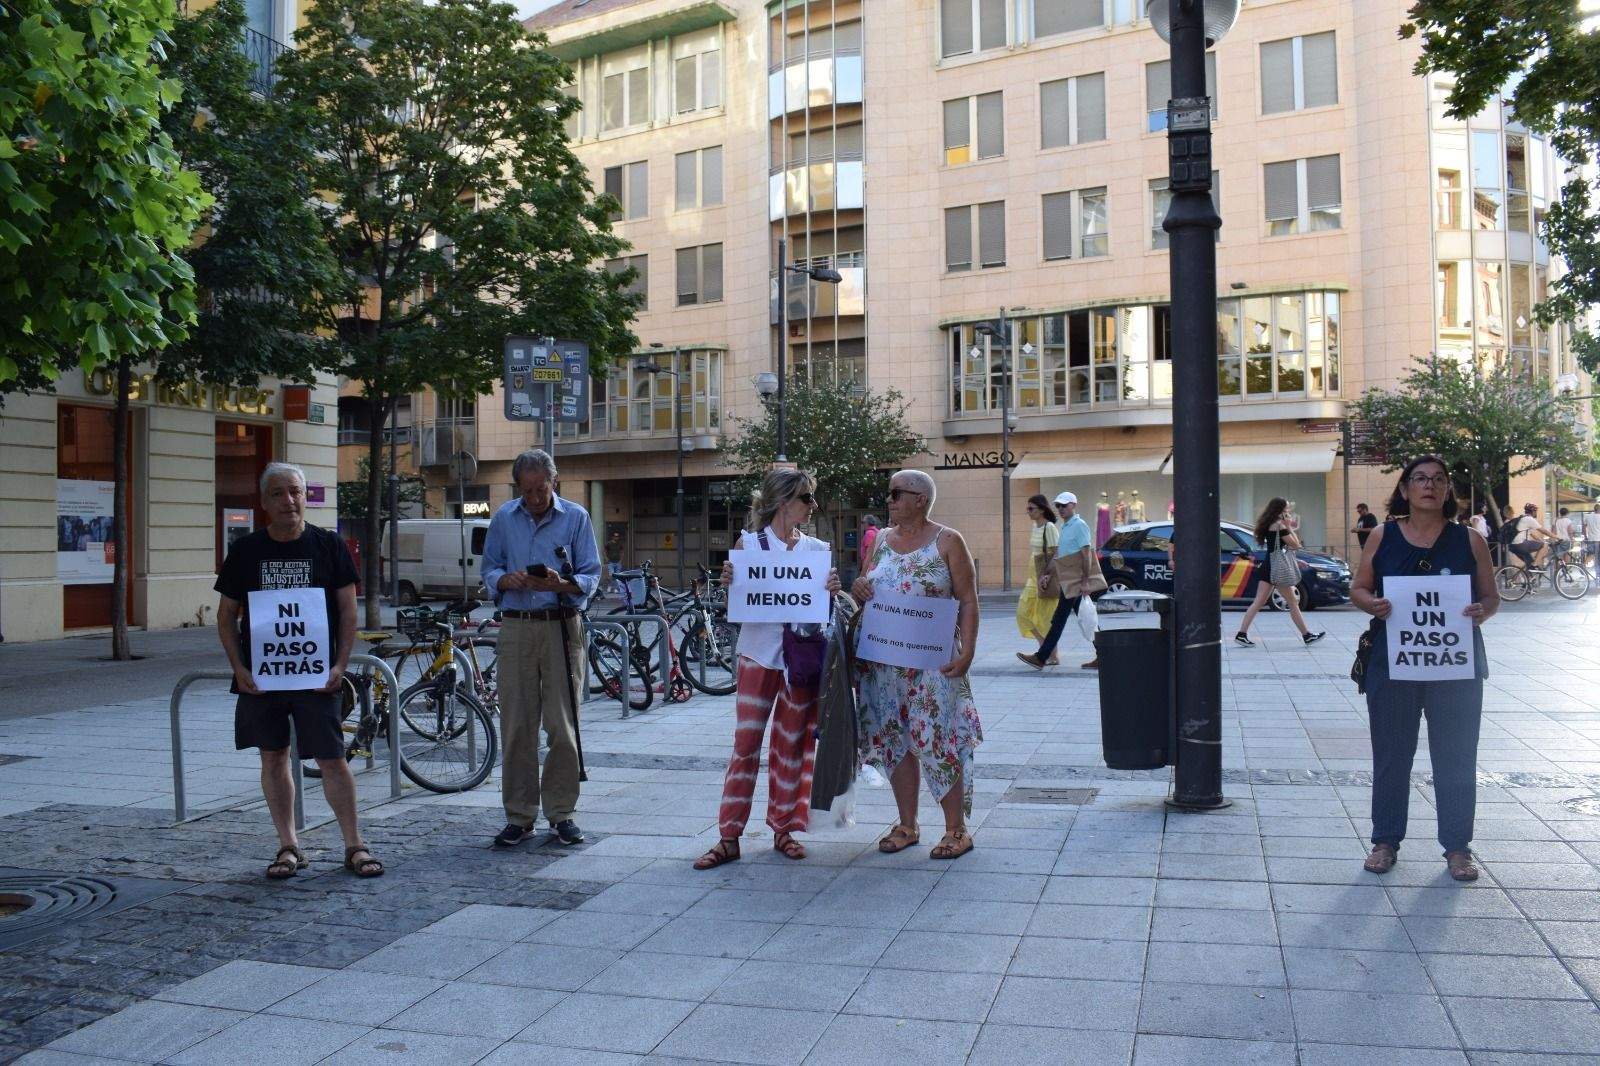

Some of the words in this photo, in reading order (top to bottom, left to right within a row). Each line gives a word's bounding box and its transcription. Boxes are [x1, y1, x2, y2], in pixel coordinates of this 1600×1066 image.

[944, 451, 1014, 467] MANGO
[463, 502, 490, 514] BBVA
[261, 573, 311, 585] INJUSTICIA
[748, 566, 767, 579] NI
[774, 566, 812, 579] UNA
[746, 592, 812, 606] MENOS
[1415, 591, 1440, 607] NI
[278, 602, 300, 618] NI
[872, 602, 884, 611] #NI
[884, 605, 901, 615] UNA
[903, 608, 934, 619] MENOS
[1412, 611, 1446, 627] UN
[275, 621, 306, 638] UN
[867, 633, 888, 645] #Vivas
[890, 640, 904, 648] nos
[906, 641, 943, 652] queremos
[1399, 630, 1460, 647] PASO
[263, 641, 318, 656] PASO
[1395, 647, 1469, 667] ATRÁS
[258, 656, 325, 676] ATRÁS
